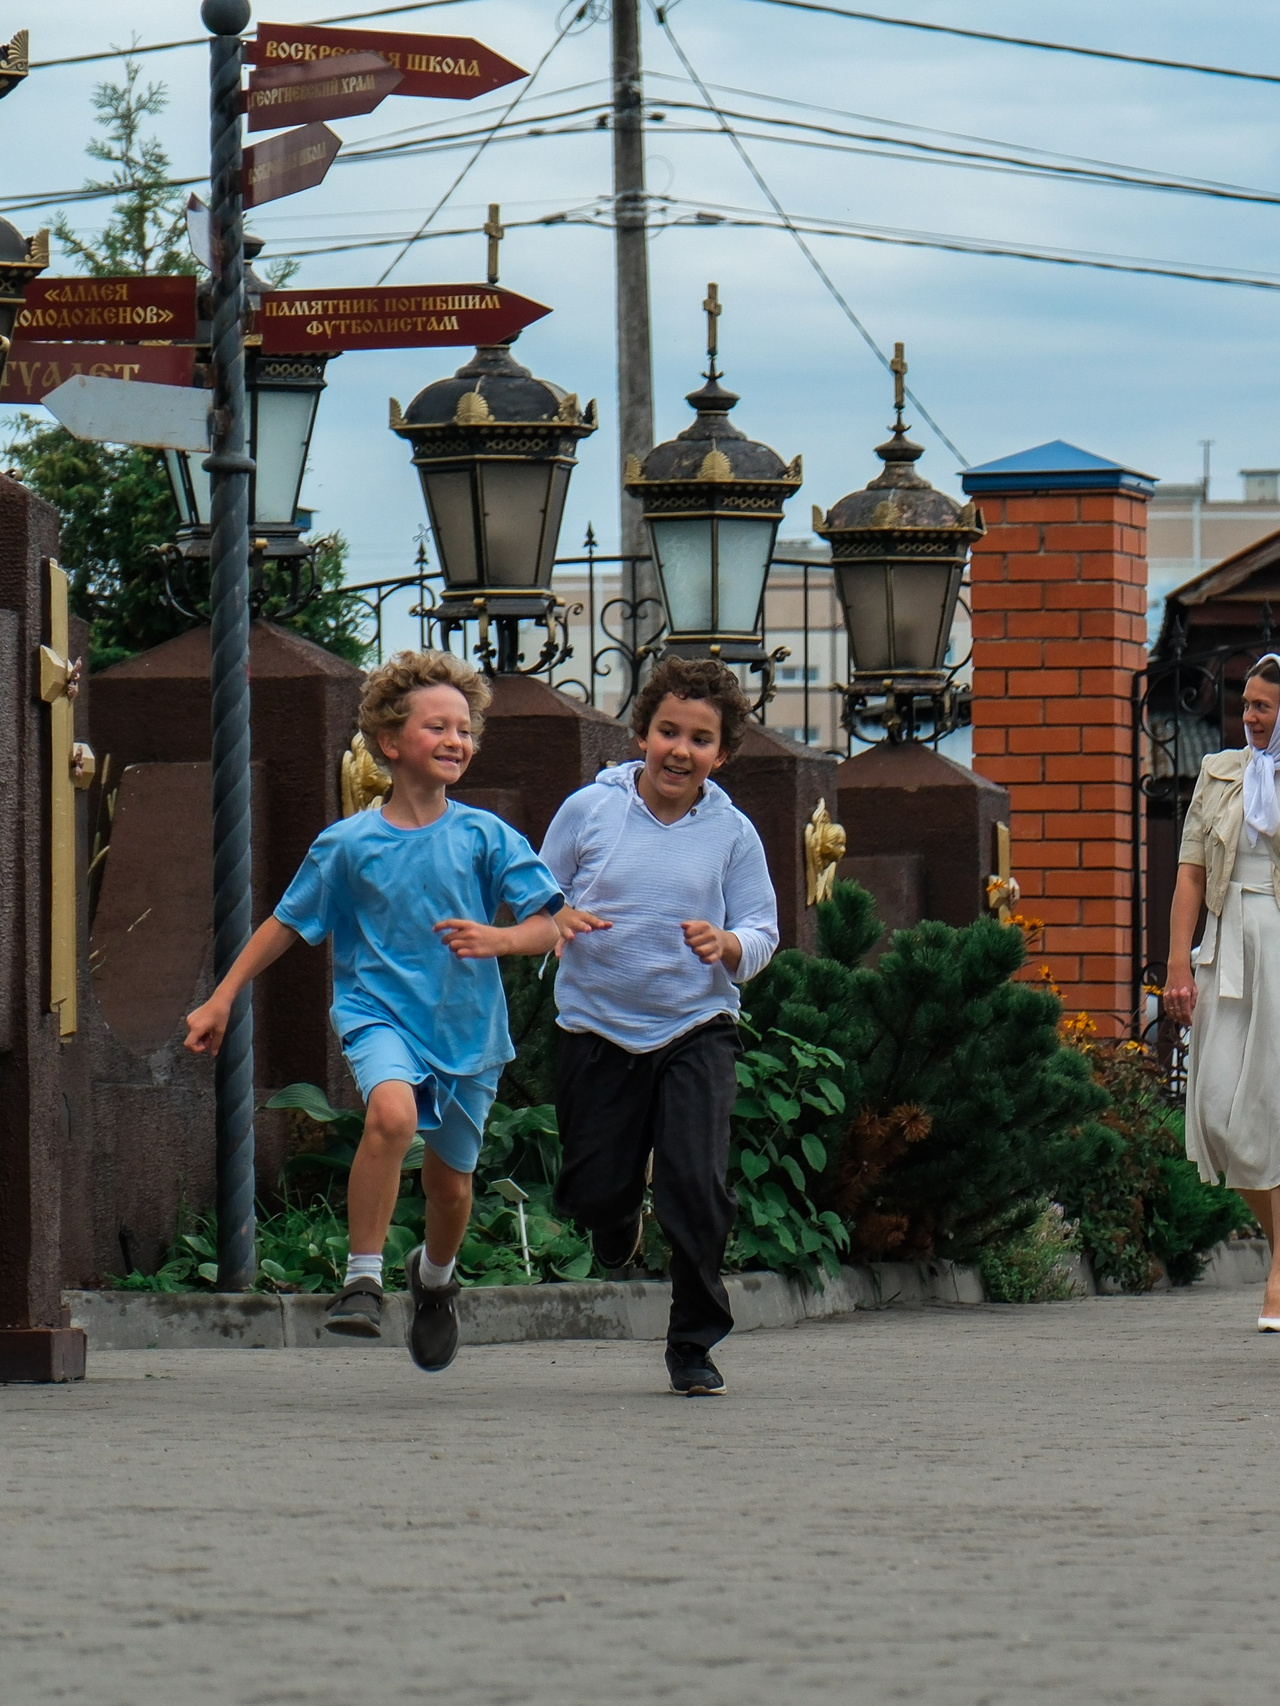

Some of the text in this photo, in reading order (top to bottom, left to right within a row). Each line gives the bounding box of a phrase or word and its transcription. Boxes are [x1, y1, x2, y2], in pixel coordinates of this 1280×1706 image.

[406, 53, 481, 78] ШКОЛА
[340, 73, 377, 95] ХРАМ
[44, 283, 129, 303] «АЛЛЕЯ
[13, 305, 175, 329] ОЛОДОЖЕНОВ»
[265, 294, 501, 318] ПАМЯТНИК ПОГИБШИМ
[305, 315, 460, 340] ФУТБОЛИСТАМ
